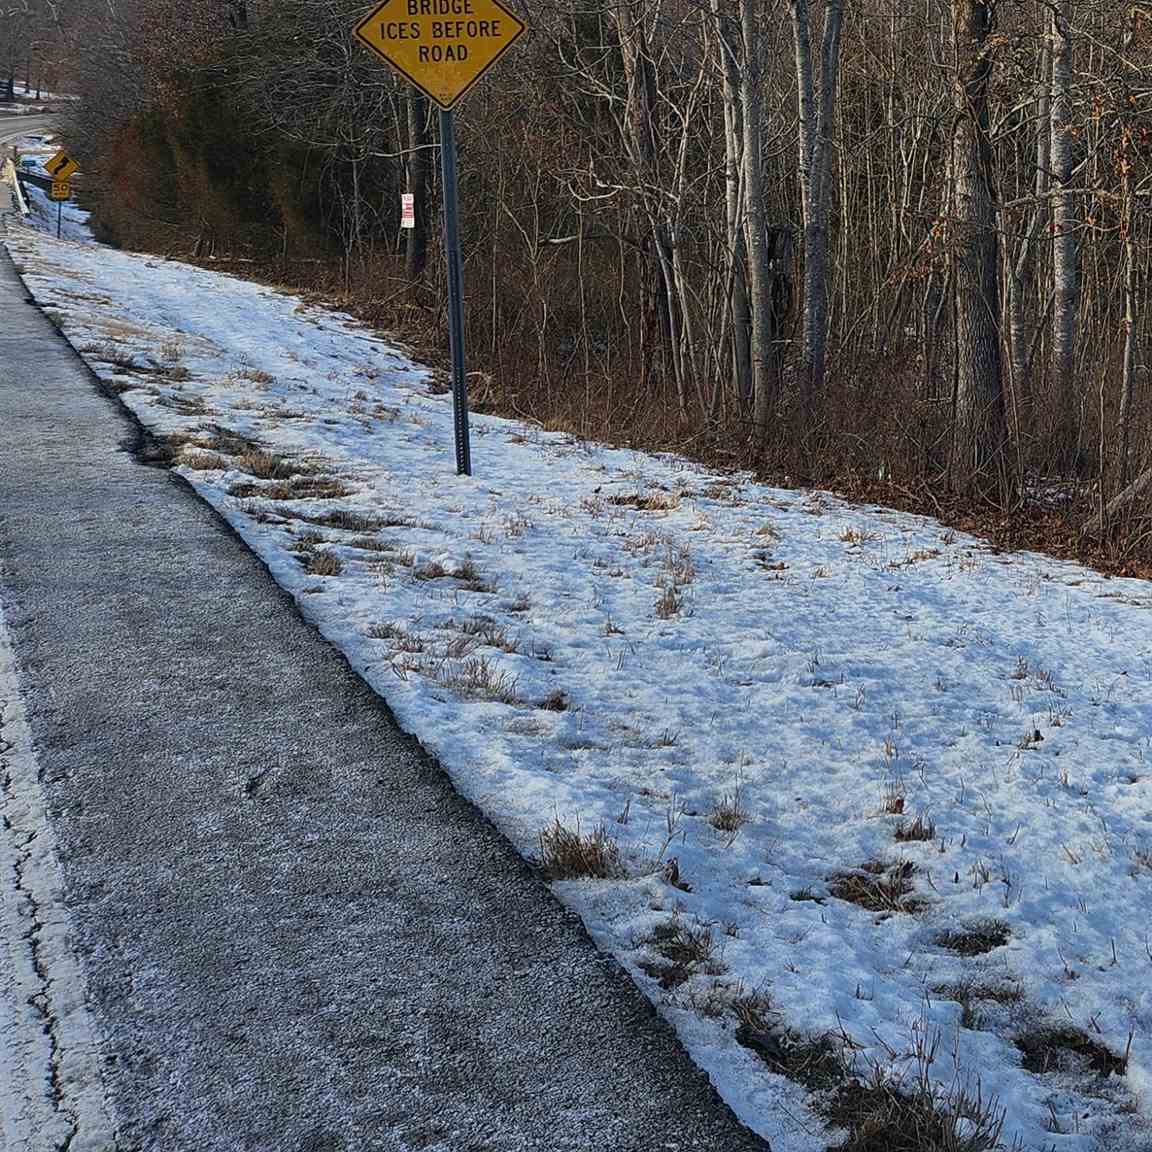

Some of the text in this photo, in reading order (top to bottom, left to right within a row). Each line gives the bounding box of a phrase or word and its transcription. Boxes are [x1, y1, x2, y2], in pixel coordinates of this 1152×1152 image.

[381, 20, 502, 40] ICES BEFORE
[419, 44, 468, 62] ROAD
[53, 183, 68, 192] 50
